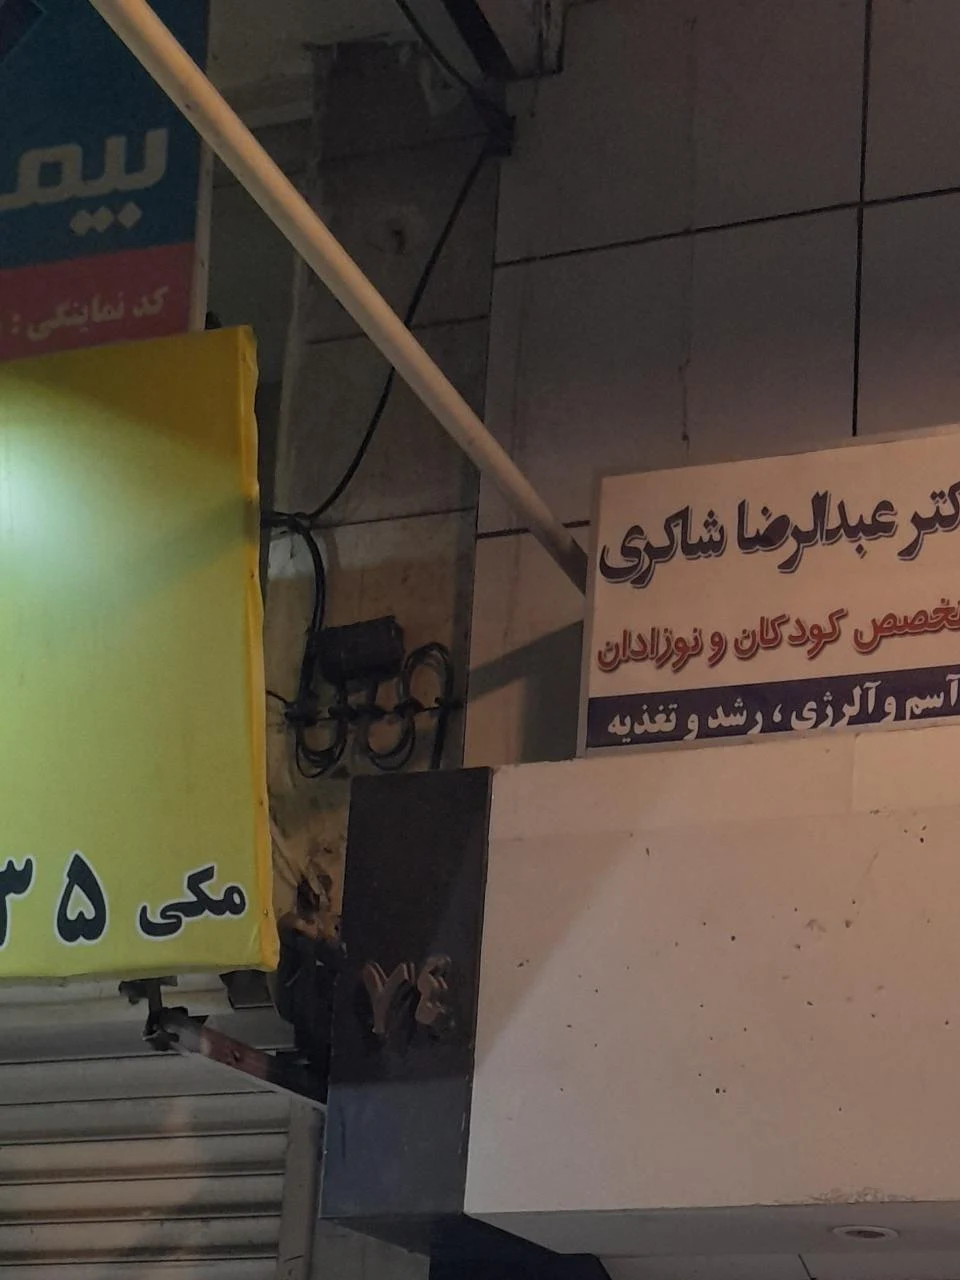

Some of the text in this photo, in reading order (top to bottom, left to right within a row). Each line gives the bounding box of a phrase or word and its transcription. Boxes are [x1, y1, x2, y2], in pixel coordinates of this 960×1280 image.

[0, 129, 168, 236] بیم
[133, 286, 168, 317] کد
[599, 505, 727, 588] شاکری
[737, 491, 898, 573] عبدالرضا
[598, 627, 704, 673] نوزادان
[708, 632, 726, 668] و
[733, 608, 847, 660] کودکان
[608, 704, 679, 744] تغذیه
[683, 716, 699, 741] و
[707, 696, 763, 736] رشد
[790, 682, 881, 731] آلرژی
[882, 696, 897, 722] و
[139, 865, 247, 937] مکی
